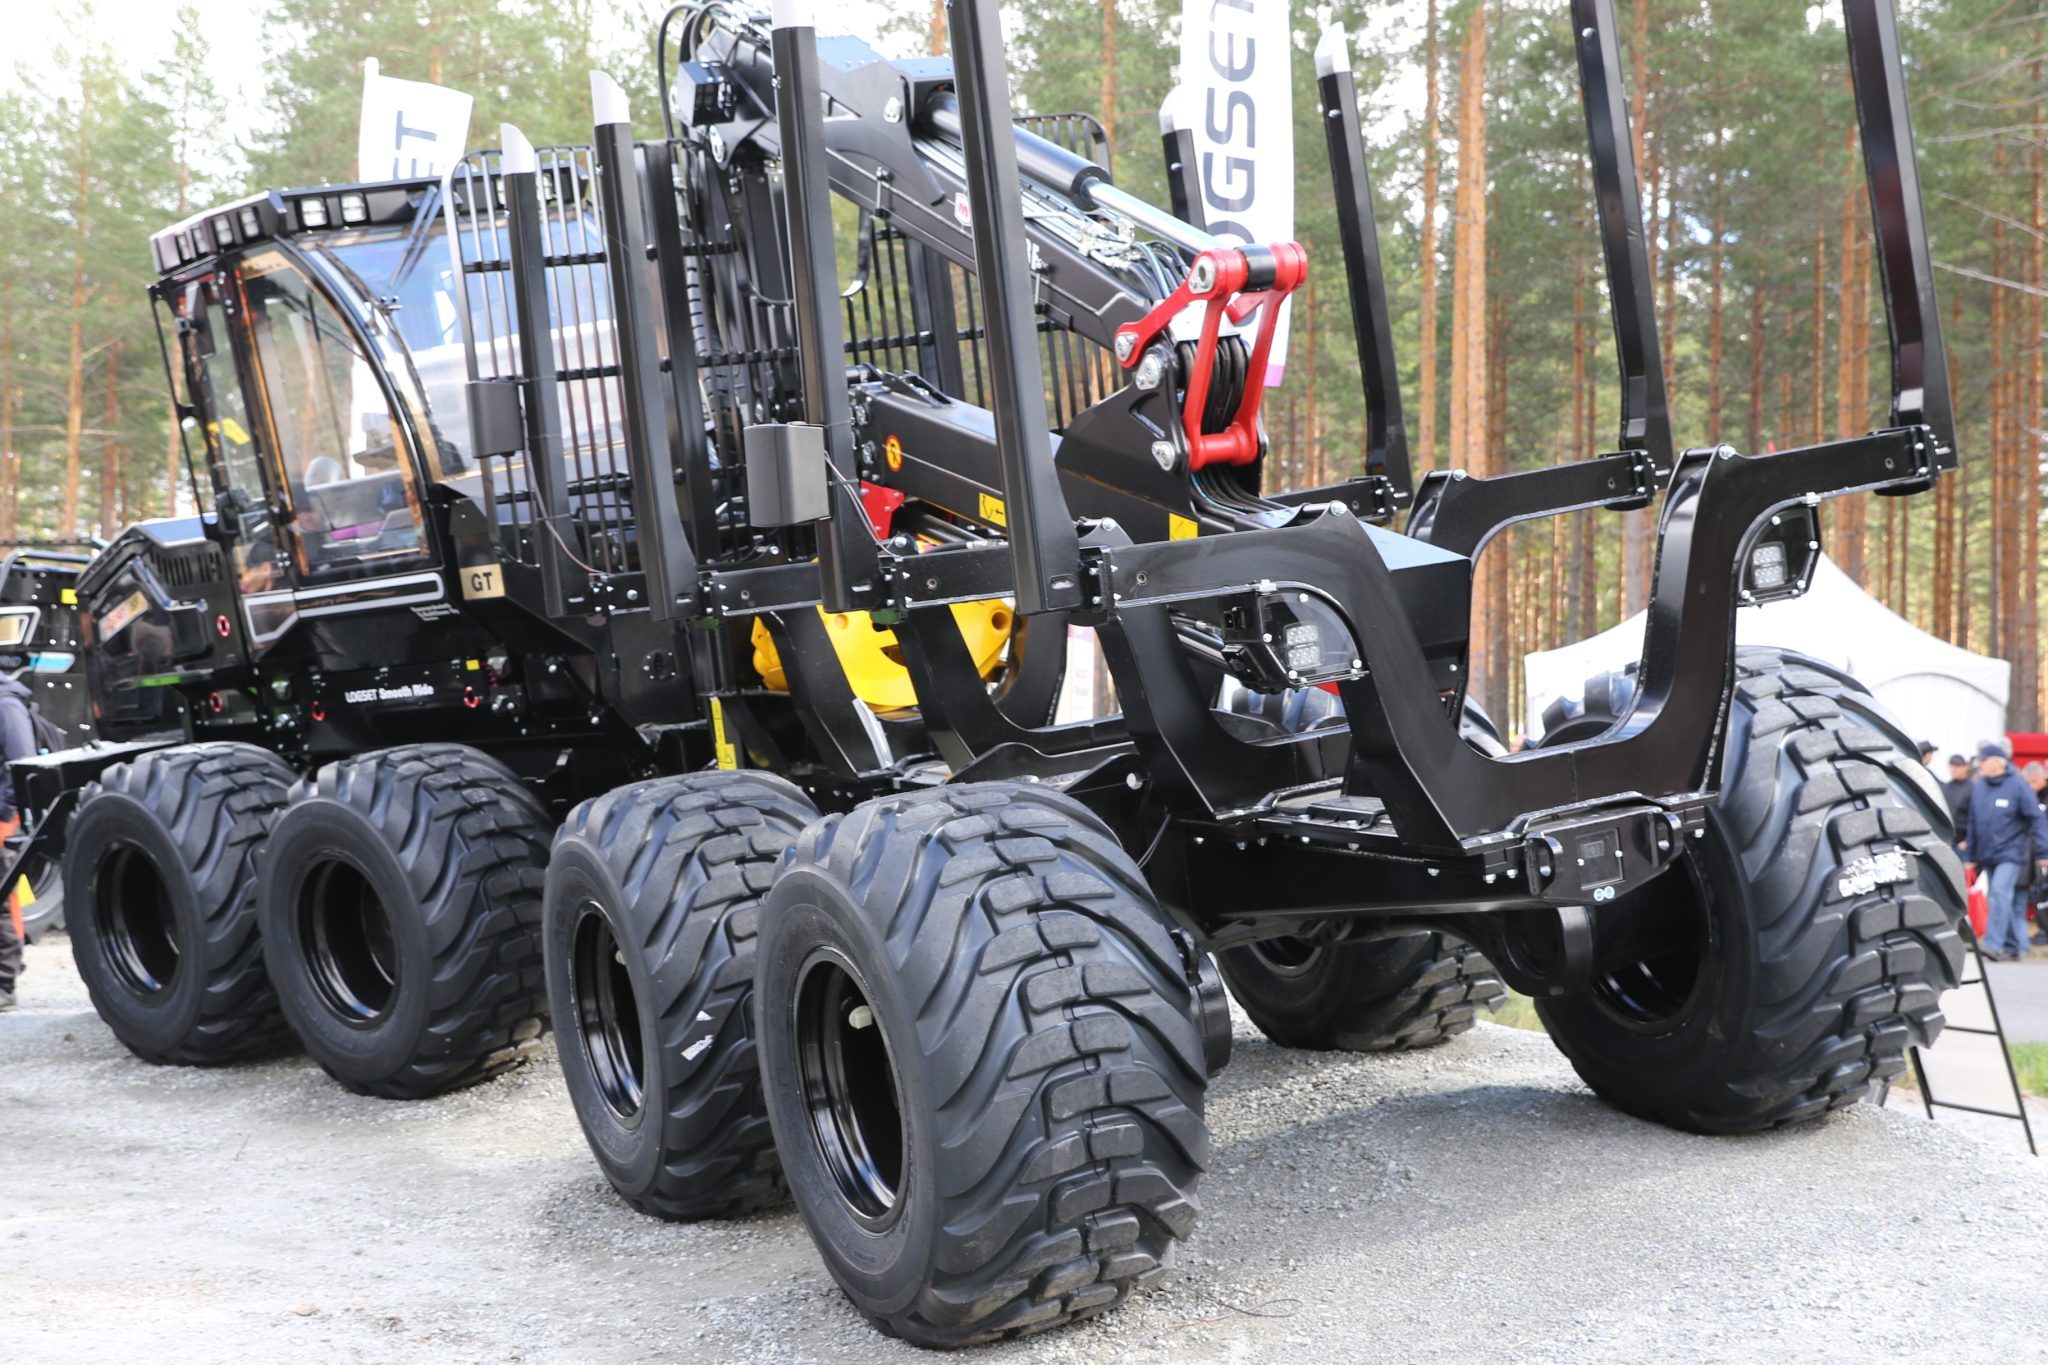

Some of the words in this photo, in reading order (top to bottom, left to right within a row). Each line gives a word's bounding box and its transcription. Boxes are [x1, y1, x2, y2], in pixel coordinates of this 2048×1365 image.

[1202, 0, 1256, 328] GSET
[471, 571, 493, 593] GT
[344, 688, 377, 703] LOGSET
[411, 683, 434, 697] Ride
